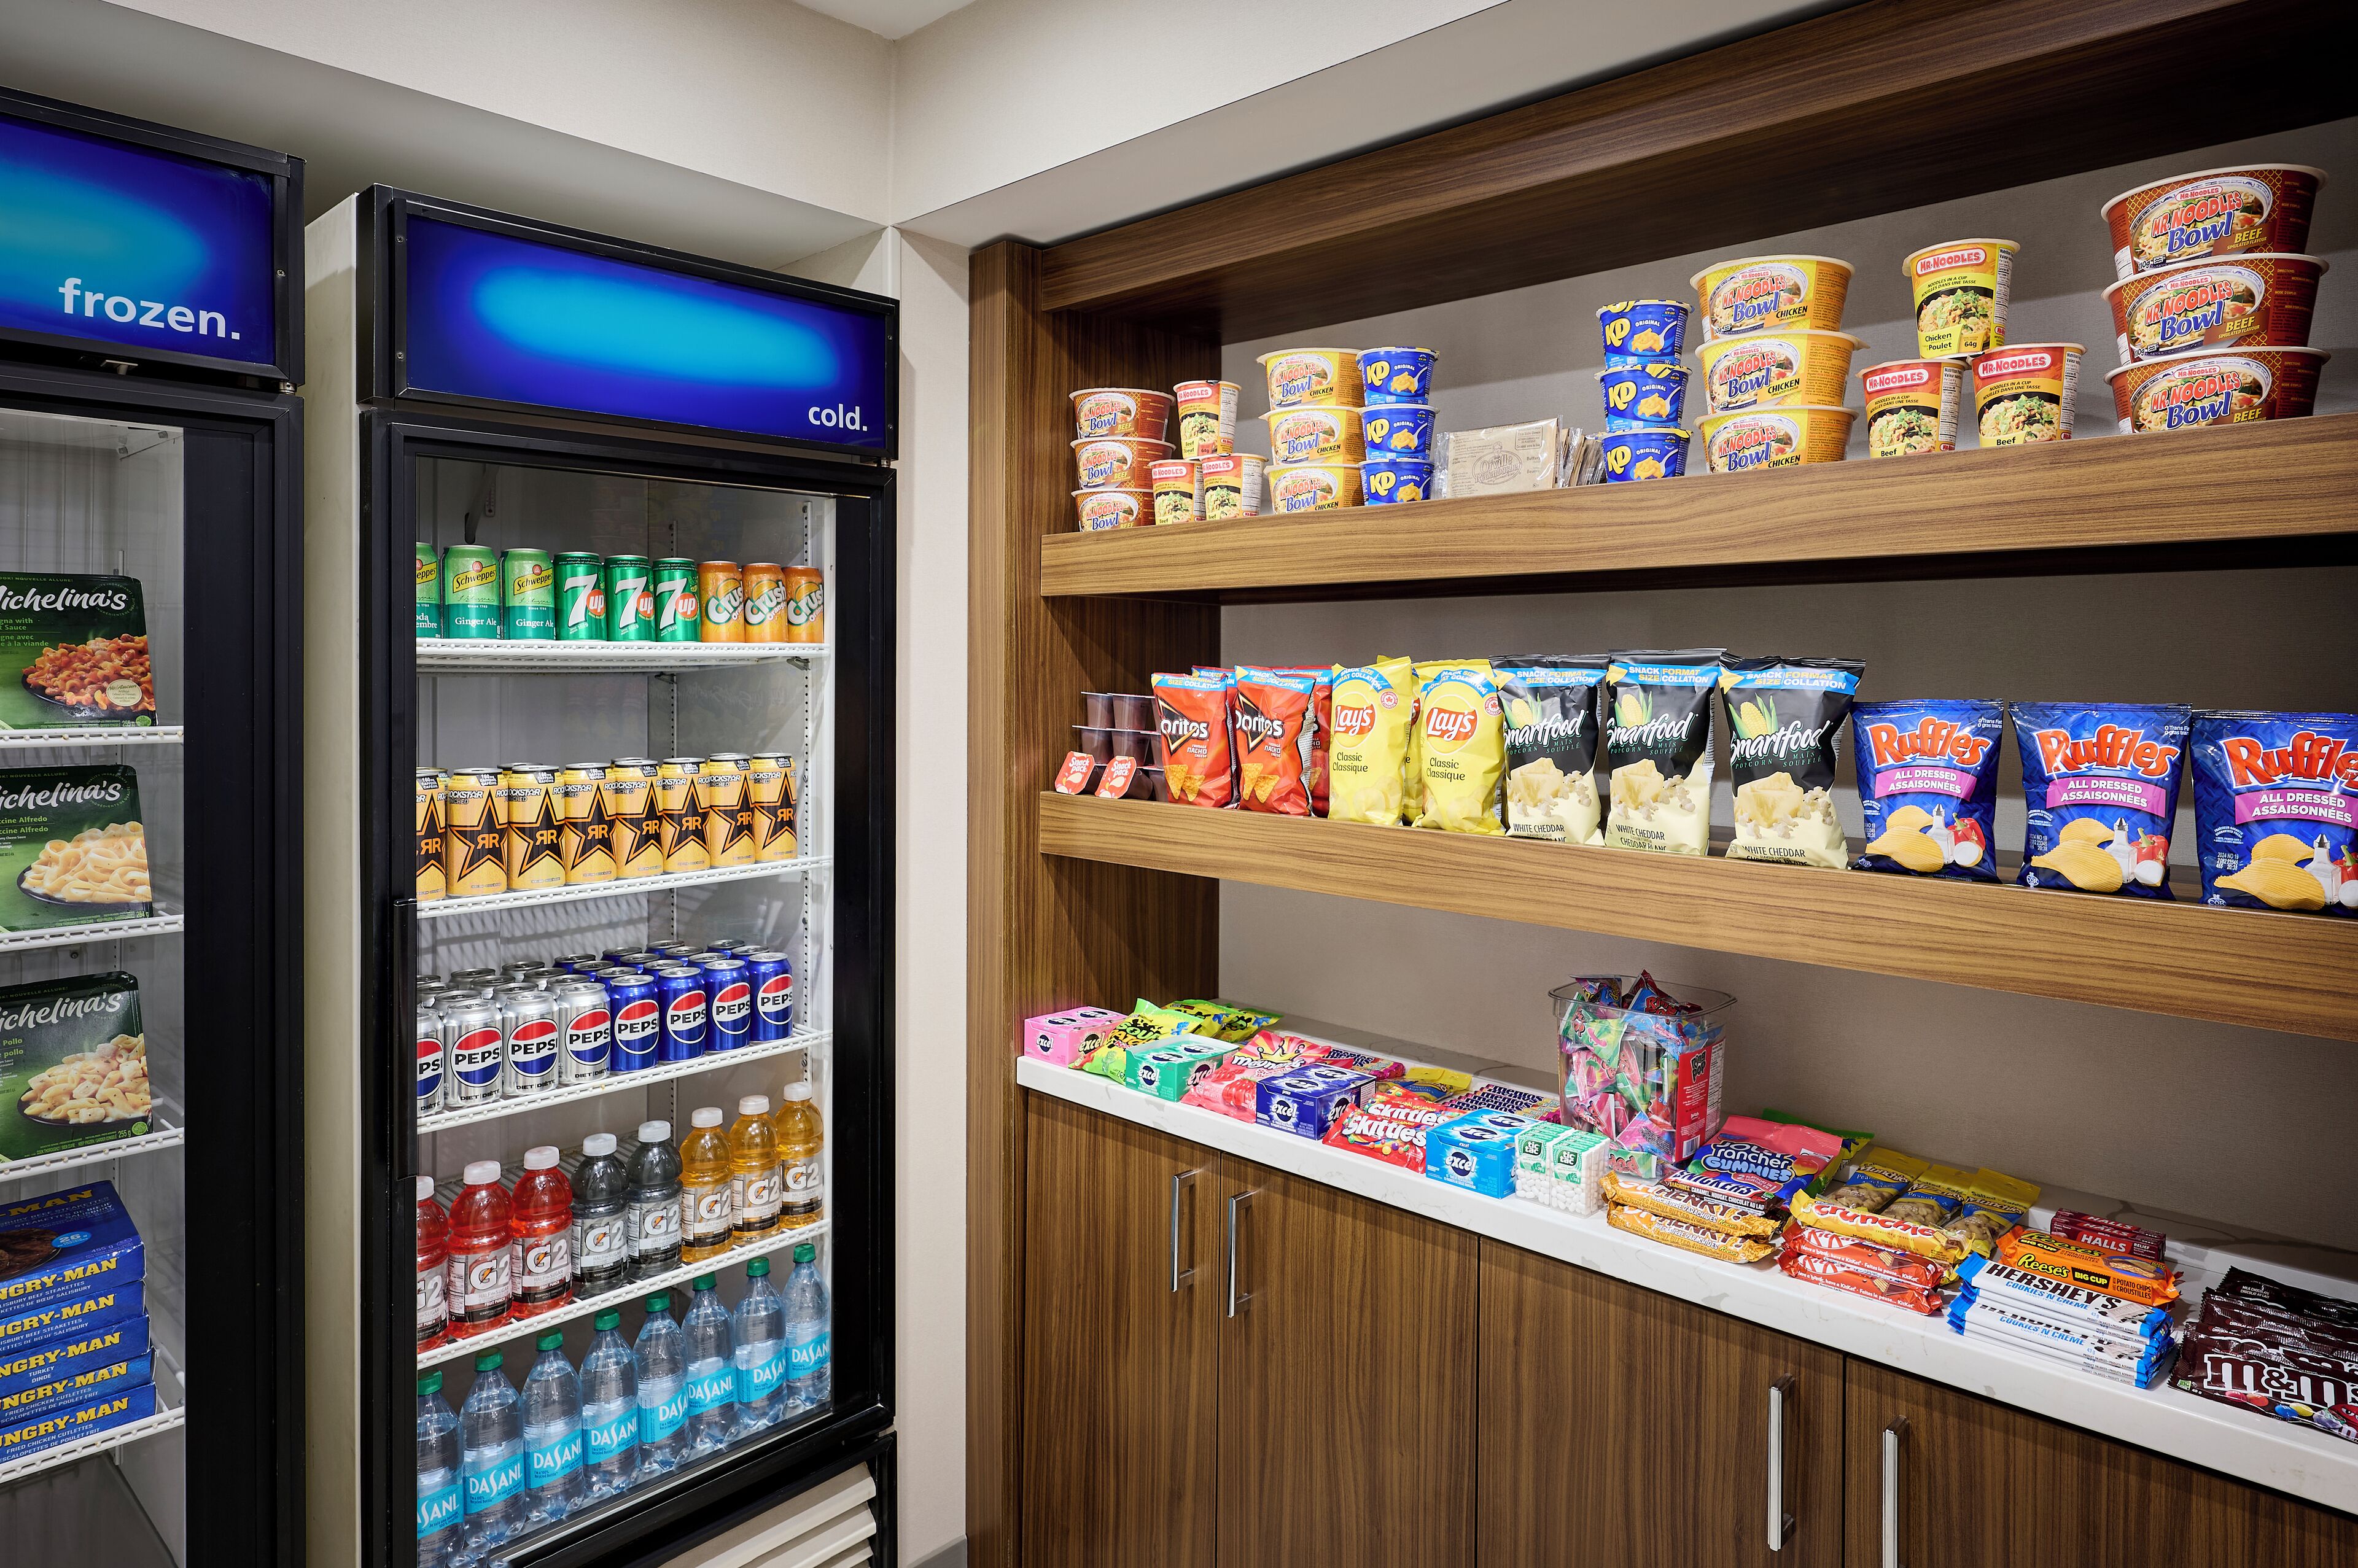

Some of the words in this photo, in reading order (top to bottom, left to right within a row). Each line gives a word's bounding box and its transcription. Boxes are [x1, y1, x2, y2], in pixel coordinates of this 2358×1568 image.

[2171, 192, 2244, 229] NOODLES
[2168, 211, 2234, 254] Bowl
[2234, 229, 2263, 243] BEEF
[2227, 240, 2250, 250] SIMULATED
[1933, 252, 1980, 268] NOODLES
[1733, 291, 1780, 323] Bowl
[2161, 280, 2233, 318] NOODLES
[58, 278, 241, 340] frozen.
[1776, 306, 1808, 319] CHICKEN
[2160, 301, 2225, 342] Bowl
[2225, 316, 2255, 333] BEEF
[1605, 317, 1631, 347] KD
[1925, 332, 1951, 342] Chicken
[2219, 328, 2241, 340] SIMULATED
[2242, 325, 2260, 333] FLAVOUR
[1929, 341, 1951, 351] Poulet
[1996, 357, 2046, 371] NOODLES
[1727, 367, 1771, 398] Bowl
[1767, 378, 1800, 394] CHICKEN
[2169, 371, 2242, 403] NOODLES
[1608, 381, 1637, 411] KD
[808, 403, 868, 432] cold.
[2166, 391, 2233, 430] Bowl
[2233, 408, 2262, 423] BEEF
[1996, 437, 2016, 446] Beef
[1481, 454, 1513, 473] Orville
[1607, 445, 1632, 475] KD
[1370, 471, 1396, 496] KD
[456, 570, 496, 589] Schweppes
[516, 573, 553, 592] Schweppes
[564, 573, 597, 629] 7
[589, 595, 604, 615] up
[615, 576, 647, 629] 7
[640, 597, 653, 615] up
[656, 578, 687, 631] 7
[679, 597, 696, 616] up
[745, 580, 787, 624] Crush
[455, 616, 484, 629] Ginger
[516, 619, 544, 629] Ginger
[1746, 671, 1783, 680] SNACK
[1785, 671, 1835, 680] FORMAT
[1783, 678, 1846, 689] COLLATION
[1335, 705, 1372, 737] Lay's
[1428, 708, 1473, 742] Lay's
[1869, 717, 1993, 766] Ruffles
[1337, 752, 1363, 762] Classic
[2036, 724, 2181, 778] Ruffles
[1069, 757, 1089, 767] Snack
[1111, 761, 1131, 771] Snack
[1333, 763, 1368, 775] Classique
[1430, 758, 1459, 769] Classic
[1426, 768, 1465, 783] Classique
[1894, 772, 1912, 780] ALL
[1915, 770, 1956, 782] DRESSED
[0, 780, 123, 810] ichelina's
[1888, 779, 1961, 794] ASSAISONNÉES
[2068, 780, 2089, 790] ALL
[2091, 782, 2142, 794] DRESSED
[2061, 791, 2147, 808] ASSAISONNÉES
[2259, 794, 2284, 804] ALL
[2286, 793, 2346, 808] DRESSED
[2252, 805, 2352, 823] ASSAISONNÉES
[1514, 823, 1533, 833] WHITE
[1534, 824, 1565, 833] CHEDDAR
[1616, 824, 1633, 834] WHITE
[1635, 828, 1665, 840] CHEDDAR
[1742, 845, 1767, 856] WHITE
[1768, 847, 1806, 857] CHEDDAR
[0, 992, 123, 1031] ichelina's
[1036, 1036, 1054, 1049] excel
[1138, 1066, 1159, 1082] excel
[1271, 1103, 1297, 1118] excel
[1342, 1115, 1426, 1147] Skittles
[1525, 1147, 1539, 1155] tac
[1717, 1147, 1789, 1168] rancher
[1445, 1155, 1477, 1173] excel
[1706, 1157, 1792, 1182] GUMMIES
[785, 1162, 819, 1190] G2
[1673, 1171, 1761, 1195] SNICKERS
[1966, 1197, 2025, 1214] Munchies
[1814, 1203, 1936, 1237] crunchie
[2081, 1234, 2126, 1252] HALLS
[526, 1238, 568, 1274] G2
[1845, 1257, 1861, 1265] KitKat
[1902, 1273, 1918, 1283] KitKat
[2018, 1254, 2069, 1277] Reese's
[2075, 1272, 2090, 1281] BIG
[2090, 1276, 2107, 1285] CUP
[1986, 1263, 2122, 1310] HERSHEY'S
[2116, 1286, 2151, 1299] CROUSTILLES
[2117, 1278, 2135, 1289] POTATO
[2136, 1284, 2151, 1292] CHIPS
[2006, 1281, 2046, 1300] COOKIES
[2057, 1297, 2090, 1310] CREME
[1999, 1316, 2039, 1332] COOKIES
[2052, 1331, 2086, 1346] CREME
[29, 1365, 55, 1377] TURKEY
[32, 1373, 52, 1383] DINDE
[689, 1376, 734, 1403] DASANI
[7, 1445, 26, 1454] FRIED
[28, 1435, 56, 1448] CHICKEN
[58, 1423, 93, 1439] CUTLETTES
[60, 1432, 84, 1444] POULET
[534, 1438, 582, 1472] DASANI
[469, 1462, 523, 1497] DASANI
